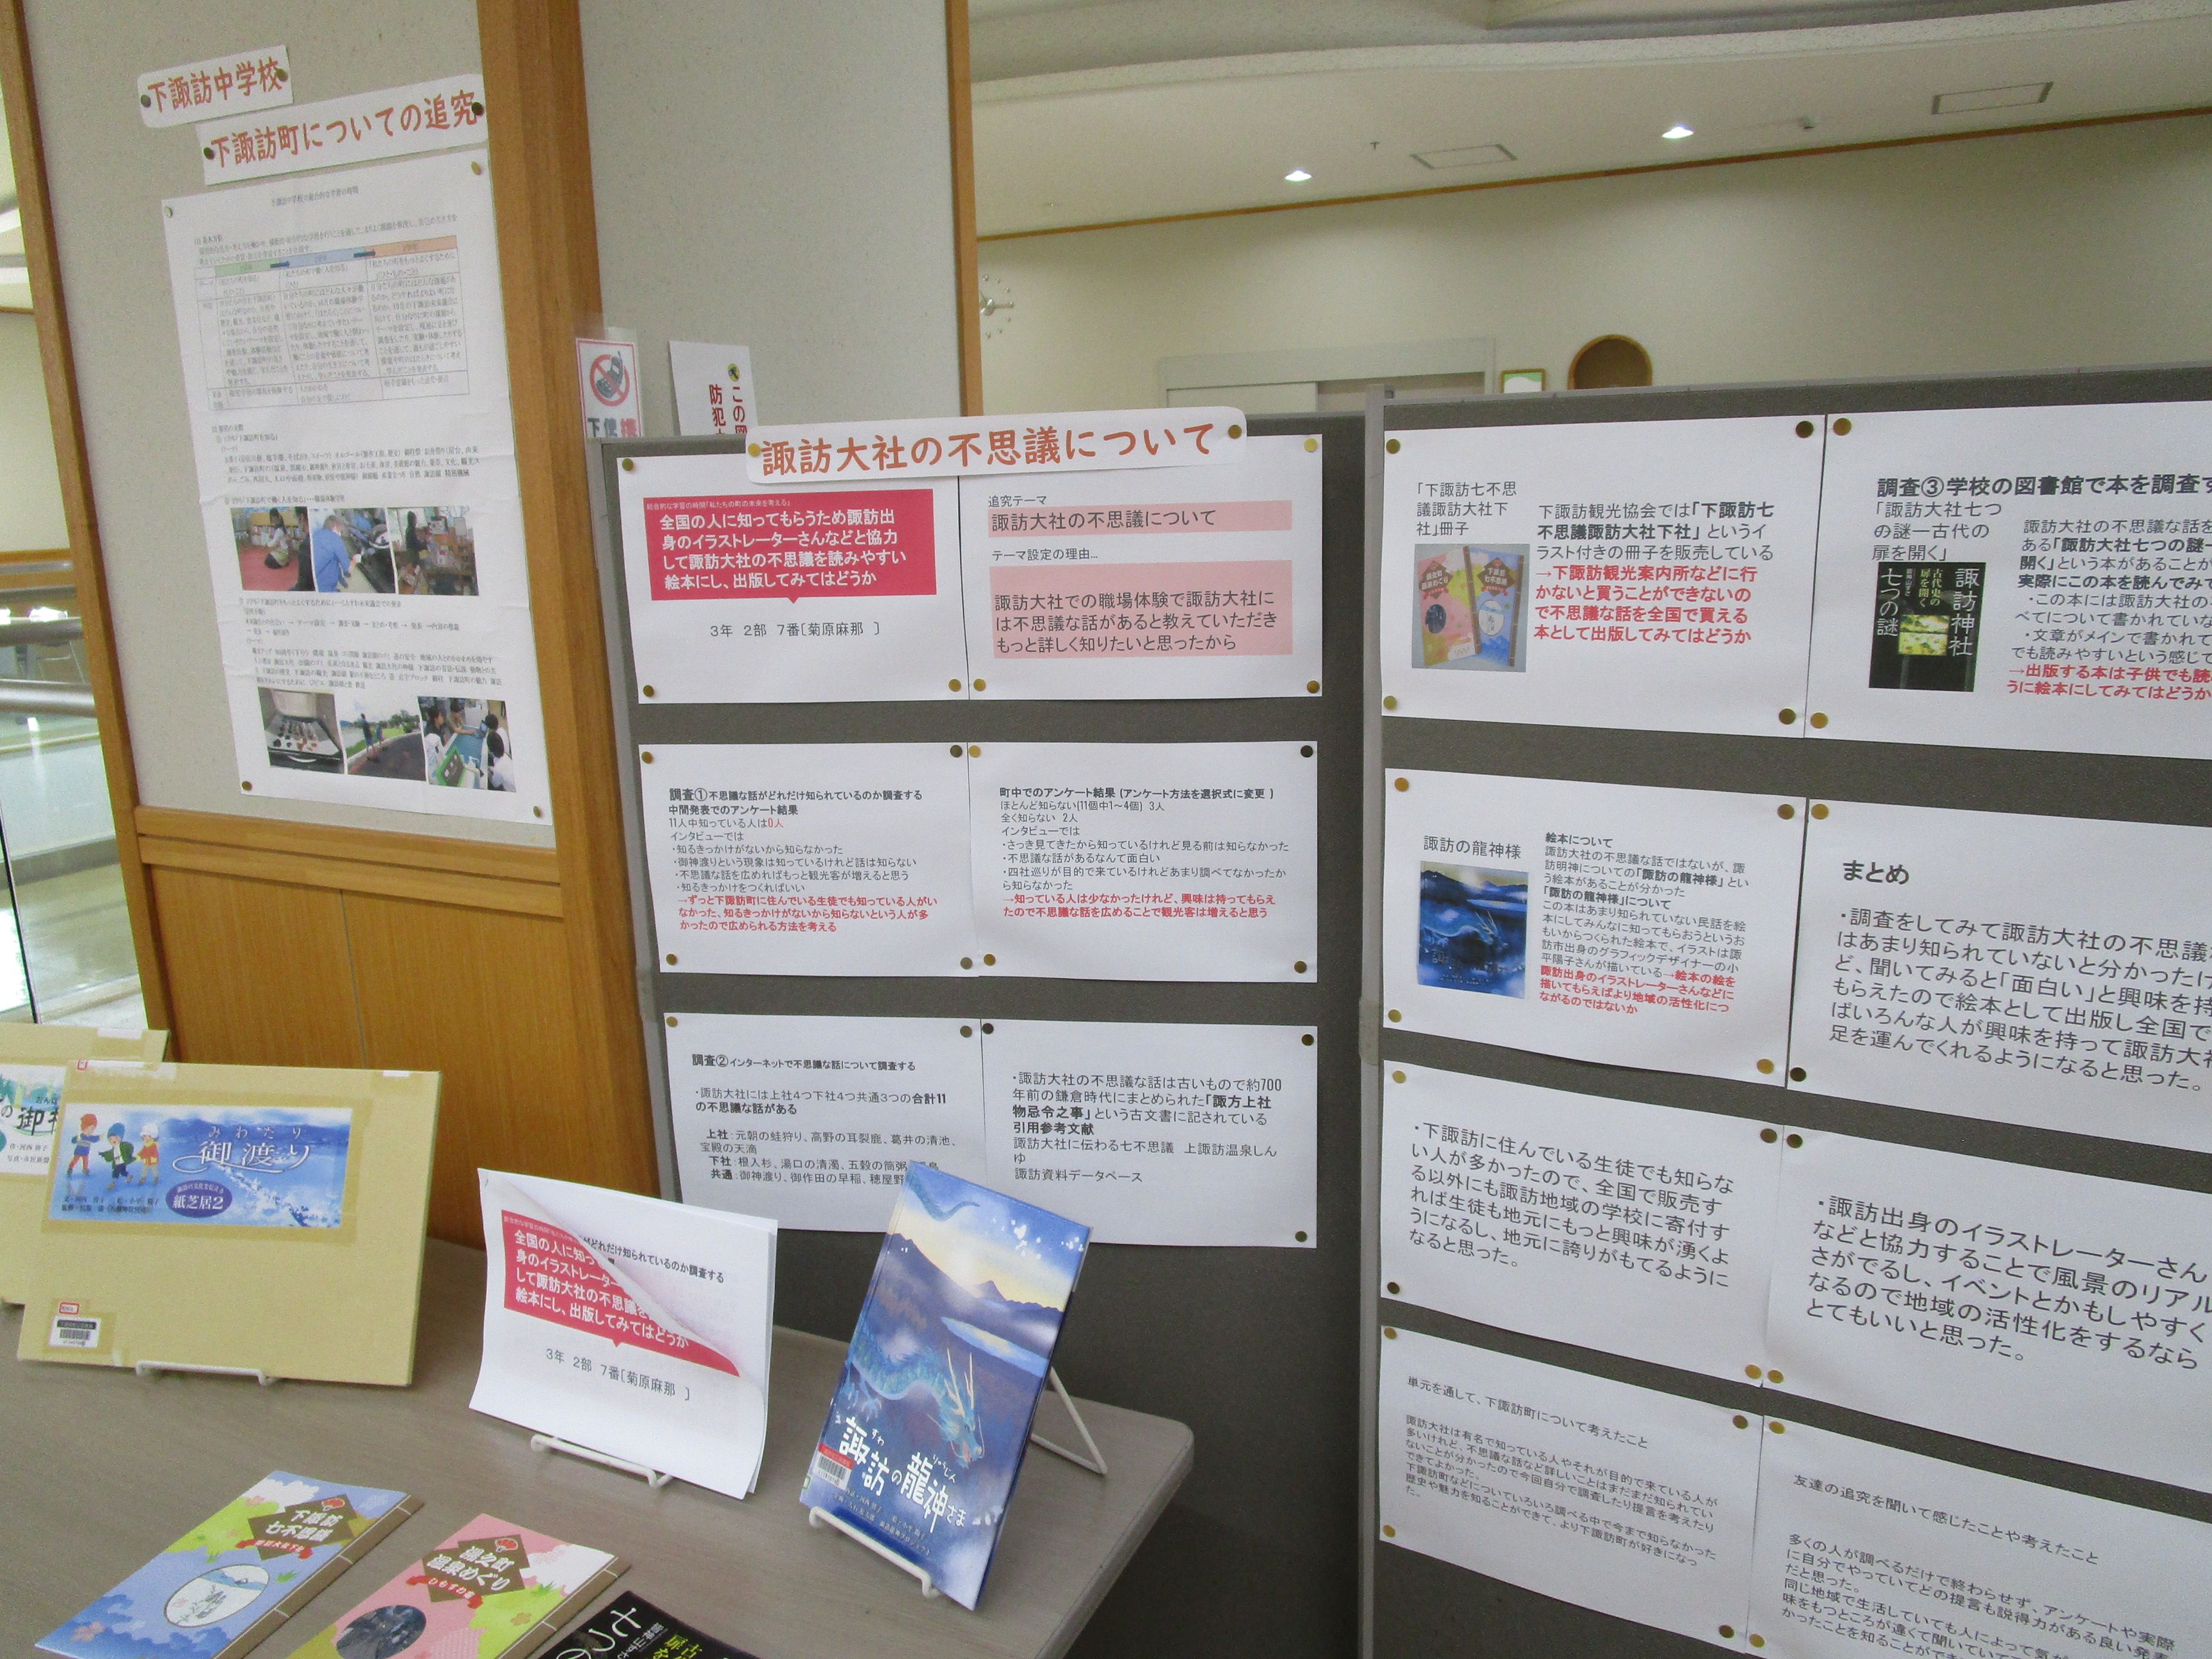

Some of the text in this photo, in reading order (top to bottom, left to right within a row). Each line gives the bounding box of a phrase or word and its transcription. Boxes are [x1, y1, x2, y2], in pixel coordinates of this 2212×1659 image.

[148, 59, 283, 113] 下諏訪中学校
[210, 90, 480, 167] 下諏訪町についての追究
[709, 384, 726, 434] 防犯
[762, 423, 1214, 475] 諏訪大社の不思議について
[1417, 481, 1517, 497] 「下諏訪七不思
[988, 495, 1047, 508] 追究テーマ
[1416, 501, 1509, 517] 議諏訪大社下
[1538, 501, 1774, 520] 下諏訪観光協会では「下諏訪七
[1875, 501, 2002, 518] 「諏訪大社七つ
[660, 509, 895, 531] 全国の人に知ってもらうため諏訪出
[991, 510, 1216, 531] 諏訪大社の不思議について
[1416, 520, 1469, 537] 社」冊子
[662, 529, 898, 550] 身のイラストレーターさんなどと協力
[1537, 523, 1767, 541] 不思議諏訪大社下社」というイ
[663, 551, 907, 569] して諏訪大社の不思議を読みやすい
[1537, 543, 1774, 561] ラスト付きの冊子を販売している
[1871, 544, 1947, 561] 扉を開く」
[665, 572, 877, 590] 絵本にし、出版してみてはどうか
[994, 591, 1275, 611] 諏訪大社での職場体験で諏訪大社に
[1535, 585, 1751, 603] かないと買うことができないの
[1877, 568, 1903, 637] 七つの謎
[2029, 593, 2212, 609] ・この本には諏訪大社の
[996, 612, 1278, 632] は不思議な話があると教えていただき
[1535, 605, 1749, 623] で不思議な話を全国で買える
[1948, 568, 1980, 657] 諏訪神社
[997, 635, 1237, 654] もっと詳しく知りたいと思ったから
[1533, 625, 1752, 645] 本として出版してみてはどうか
[2025, 663, 2212, 684] 出版する本は子供でも読
[2006, 680, 2212, 702] うに絵本にしてみてはどうか
[669, 805, 799, 816] 中間発表でのアンケート結果
[1001, 813, 1056, 823] 全く知らない
[669, 817, 784, 829] 11人中知っている人は0人
[1002, 826, 1080, 837] インタビューでは
[671, 831, 744, 842] インタビューでは
[1423, 834, 1522, 860] 諏訪の龍神様
[1545, 832, 1613, 848] 絵本について
[1545, 845, 1746, 874] 諏訪大社の不思議な話ではないが、諏
[1842, 859, 1909, 885] まとめ
[1003, 880, 1073, 891] ら知らなかった
[1544, 873, 1686, 897] う絵本があることが分かった
[1544, 885, 1672, 910] 「諏訪の龍神様」について
[1004, 907, 1268, 919] たので不思議な話を広めることで観光客は増えると思う
[1543, 900, 1746, 933] この本はあまり知られていない民話を絵
[680, 920, 837, 933] かったので広められる方法を考える
[1543, 913, 1744, 946] 本にしてみんなに知ってもらおうというお
[1840, 907, 2212, 963] ・調査をしてみて諏訪大社の不思議
[1542, 939, 1739, 974] 訪市出身のグラフィックデザイナーの小
[1541, 965, 1734, 1000] 諏訪出身のイラストレーターさんなどに
[1540, 991, 1638, 1014] ながるのではないか
[1832, 977, 2212, 1042] もらえたので絵本として出版し全国で
[1828, 1024, 2201, 1092] 足を運んでくれるようになると思った。
[695, 1101, 797, 1115] の不思議な話がある
[209, 1125, 301, 1139] みわたり
[1013, 1122, 1094, 1135] 引用参考文献
[198, 1140, 309, 1169] 御渡り
[700, 1142, 757, 1155] 宝殿の天滴
[1013, 1138, 1277, 1157] 諏訪大社に伝わる七不思議 上諏訪温泉しん
[1014, 1153, 1026, 1164] ゆ
[1014, 1168, 1143, 1182] 諏訪資料データベース
[1412, 1143, 1723, 1216] い人が多かったので、全国で販売す
[172, 1195, 225, 1210] 紙芝居2
[1412, 1165, 1731, 1241] る以外にも諏訪地域の学校に寄付す
[1410, 1186, 1729, 1265] れば生徒も地元にもっと興味が湧くよ
[515, 1230, 595, 1265] 全国の人に知っ
[1409, 1228, 1519, 1268] なると思った。
[1410, 1208, 1729, 1288] うになるし、地元に誇りがもてるように
[1813, 1219, 2212, 1314] などと協力することで風景のリアル
[1811, 1245, 2205, 1343] さがでるし、イベントとかもしやすく
[1806, 1299, 2024, 1361] とてもいいと思った。
[1808, 1272, 2198, 1370] なるので地域の活性化をするなら
[1408, 1375, 1649, 1449] 単元を通して、下諏訪町について考えたこと
[839, 1415, 967, 1533] 諏訪の龍神さま
[1406, 1451, 1480, 1480] できてよかった。
[1793, 1474, 2099, 1566] 友達の追究を聞いて感じたことや考えたこと
[426, 1553, 511, 1592] 温泉めぐり
[1785, 1563, 1860, 1593] だと思った。
[1783, 1592, 2019, 1659] 味をもつところが違くて聞いてい
